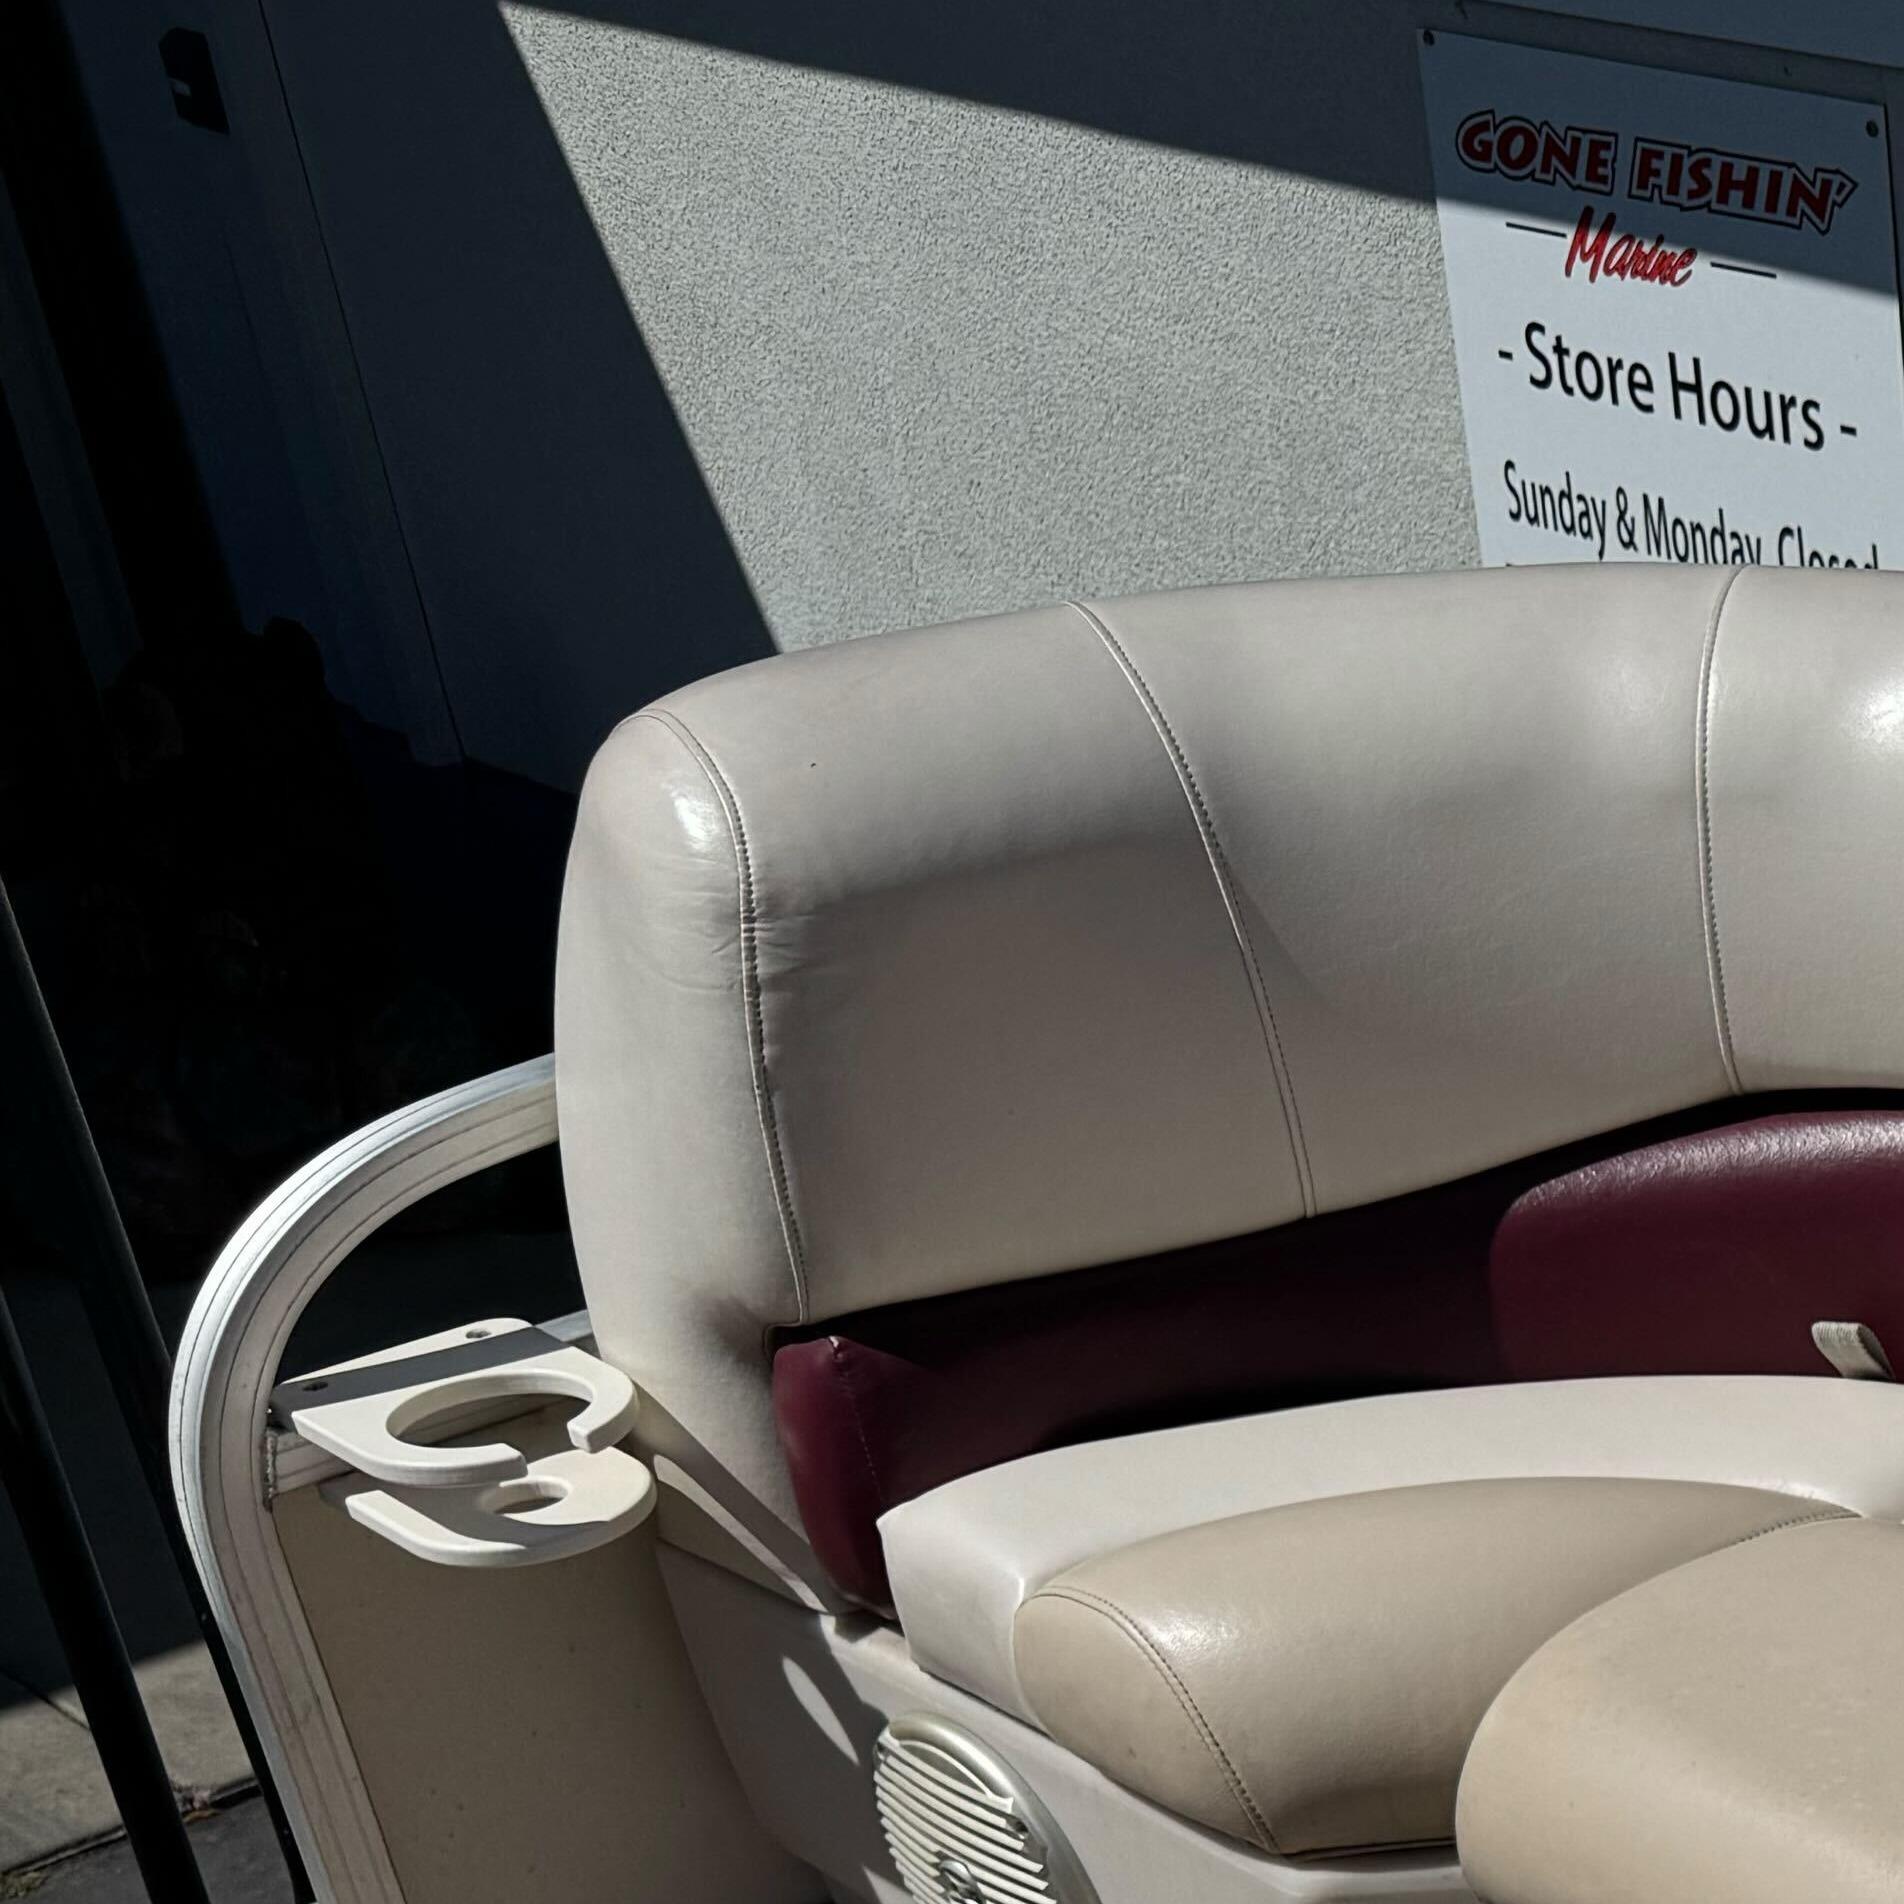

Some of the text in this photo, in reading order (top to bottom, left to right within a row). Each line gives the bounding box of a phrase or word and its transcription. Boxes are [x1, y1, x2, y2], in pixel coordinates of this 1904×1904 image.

[1456, 110, 1858, 236] GONE FISHIN'
[1565, 206, 1698, 287] Marine
[1524, 322, 1654, 413] Store
[1668, 352, 1824, 451] Hours
[1504, 459, 1606, 561] Sunday
[1616, 486, 1638, 553] &
